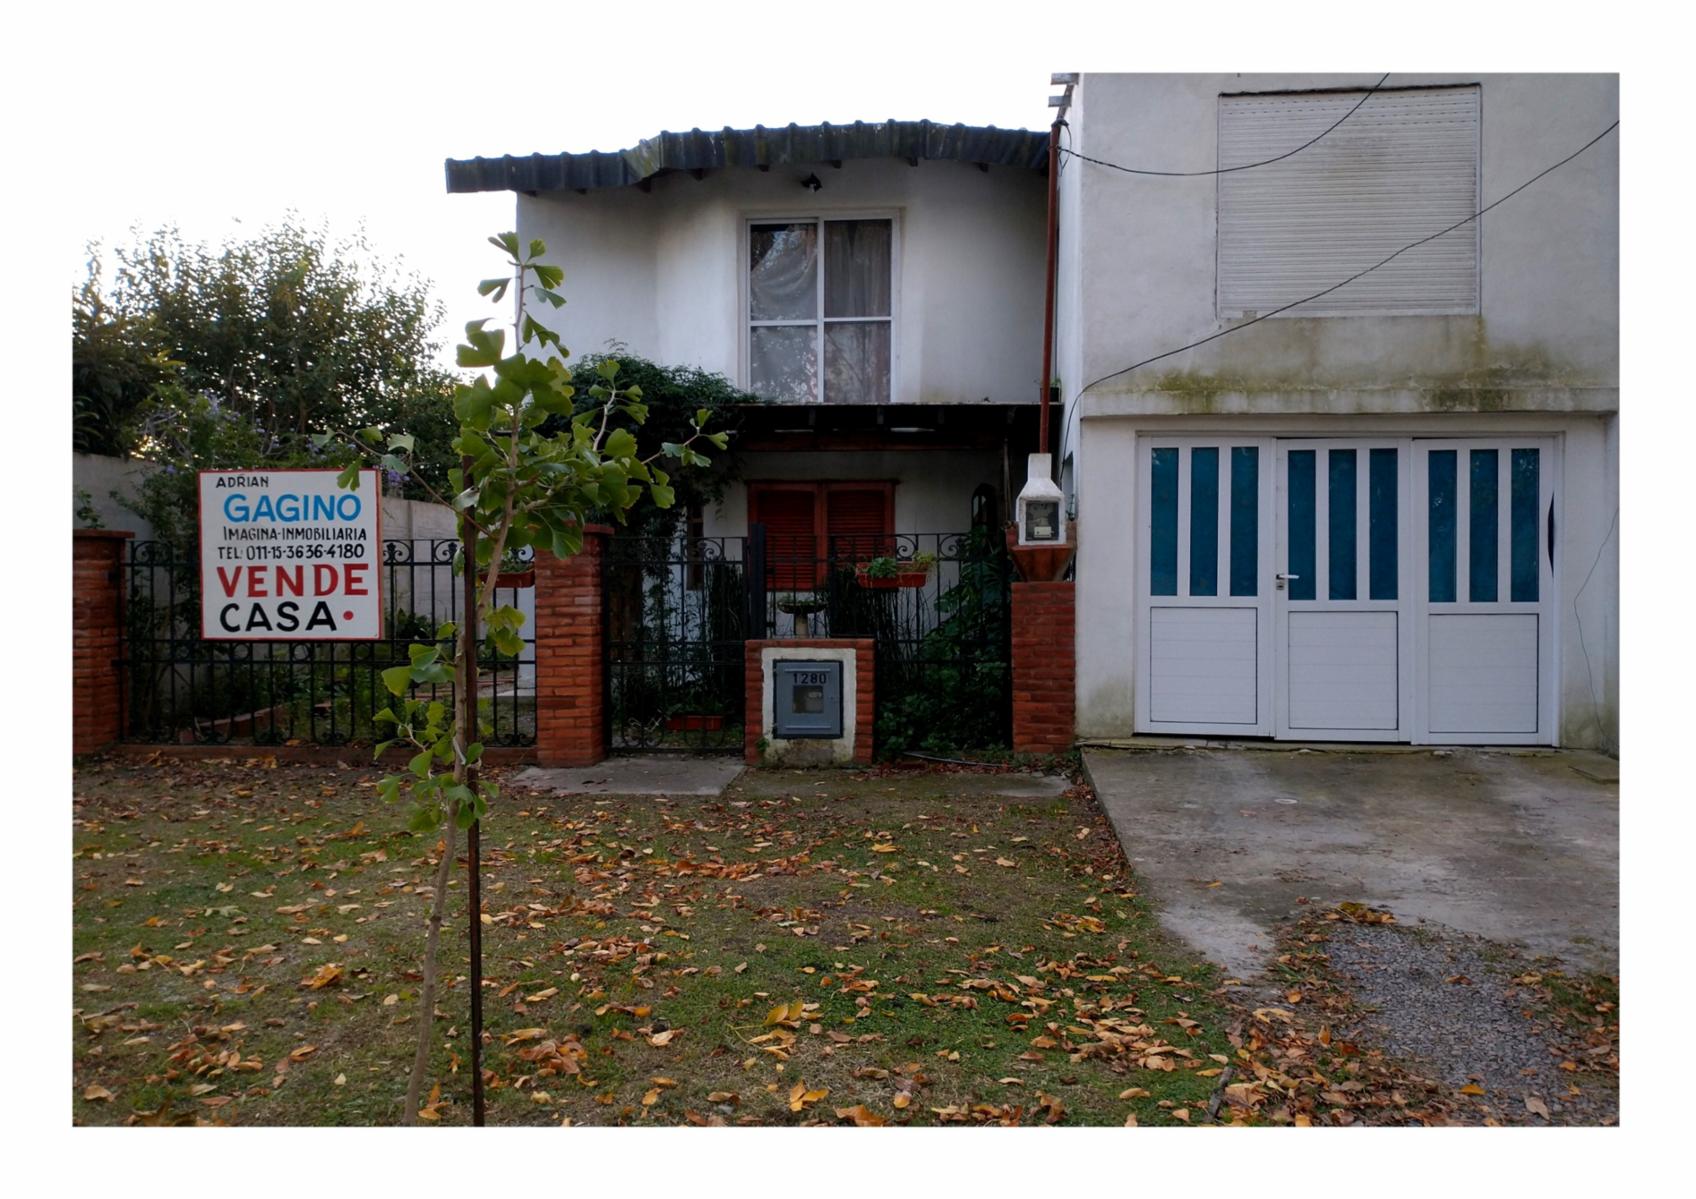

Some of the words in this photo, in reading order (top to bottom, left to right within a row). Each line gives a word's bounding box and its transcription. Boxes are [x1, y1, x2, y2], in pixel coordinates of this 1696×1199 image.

[216, 475, 269, 488] ADRIAN
[223, 494, 362, 522] GAGINO
[223, 526, 367, 541] IMAGINA-INMOBILIARIA
[246, 544, 364, 560] 011-15-3636-4180
[216, 563, 369, 598] VENDE
[792, 673, 828, 685] 1280
